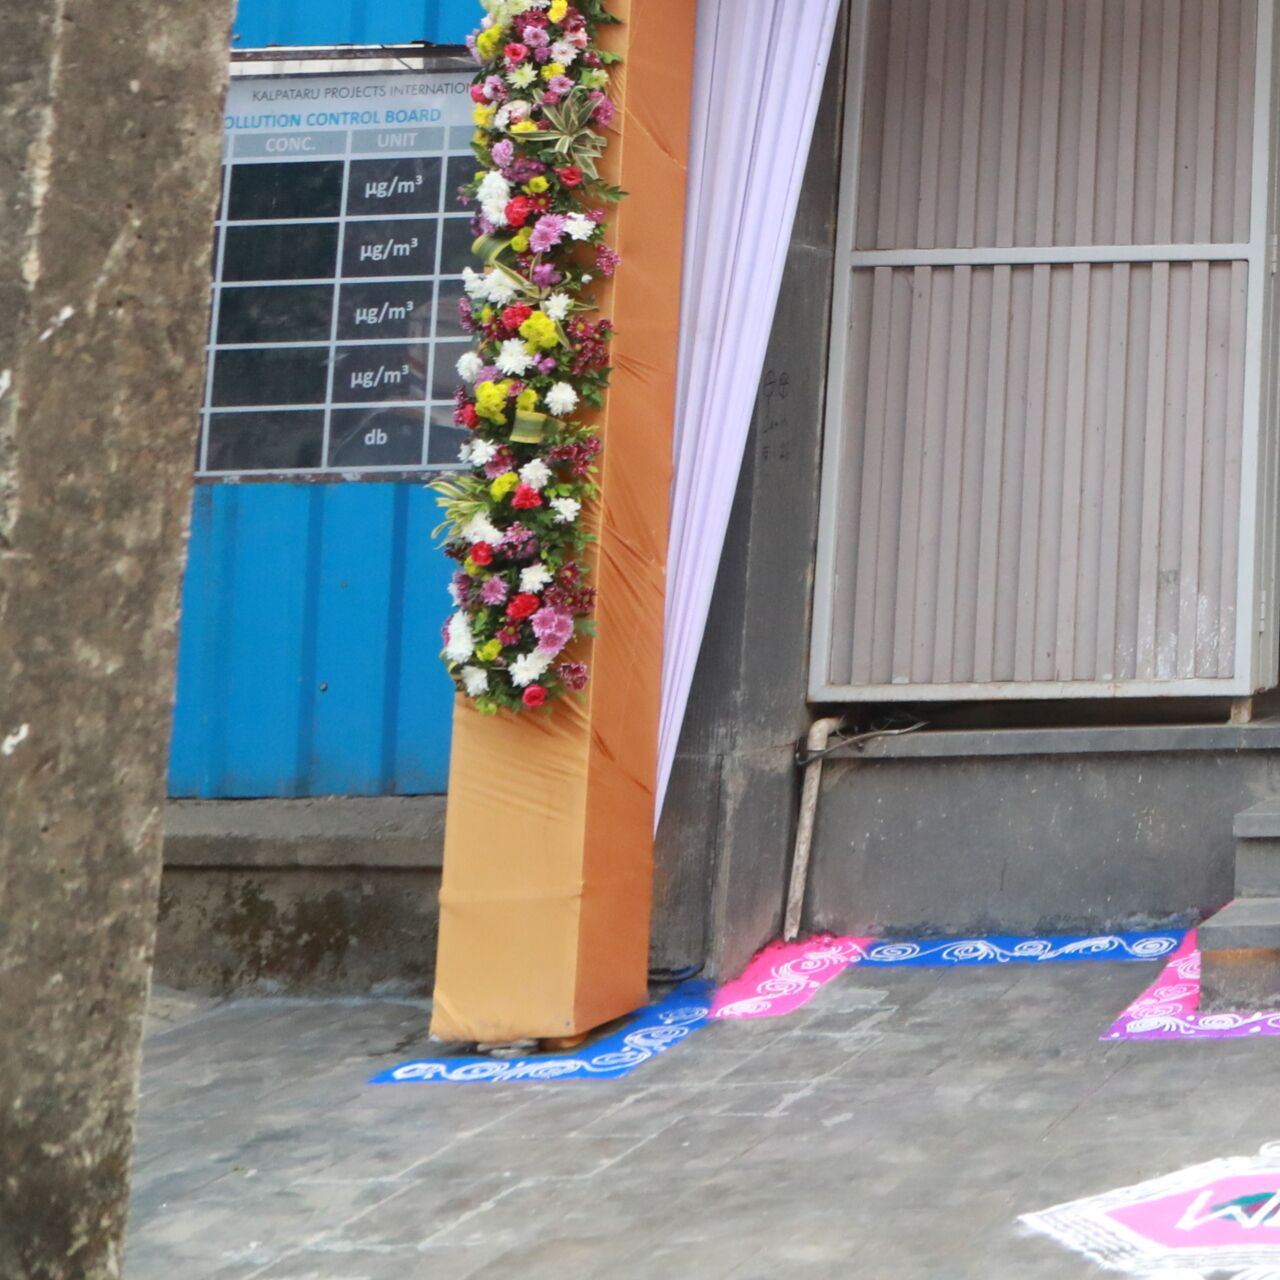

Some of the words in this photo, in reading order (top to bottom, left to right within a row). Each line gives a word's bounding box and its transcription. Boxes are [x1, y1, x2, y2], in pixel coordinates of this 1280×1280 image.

[252, 88, 320, 102] KALPATARU
[324, 85, 386, 99] PROJECTS
[306, 111, 380, 126] CONTROL
[385, 108, 441, 123] BOARD
[265, 136, 316, 152] CONC.
[377, 132, 418, 148] UNIT
[364, 428, 388, 445] db
